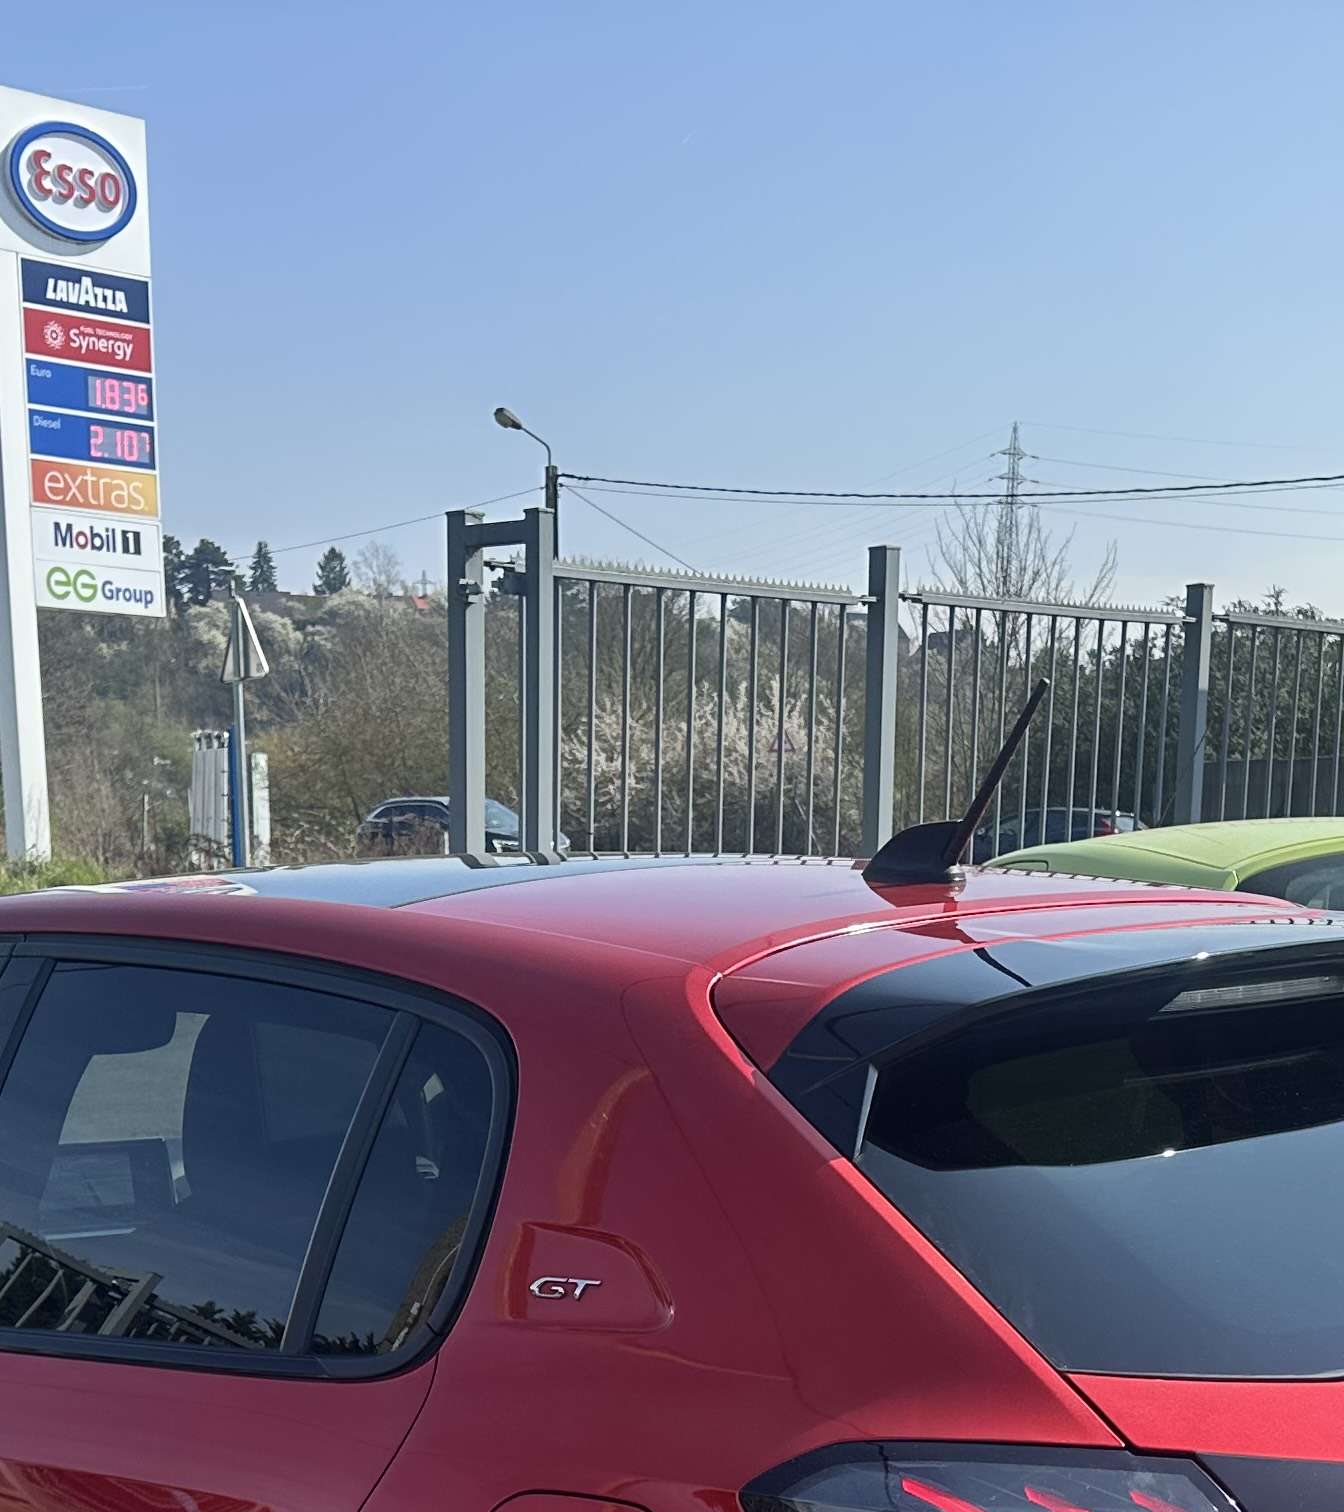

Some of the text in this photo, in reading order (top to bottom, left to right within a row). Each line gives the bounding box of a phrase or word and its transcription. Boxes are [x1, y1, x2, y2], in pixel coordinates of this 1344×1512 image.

[46, 276, 128, 313] LAVAZZA
[69, 328, 133, 361] Synergy
[30, 364, 52, 378] Euro
[33, 415, 61, 430] Diesel
[53, 521, 138, 555] Mobil 1
[101, 580, 154, 609] Group
[529, 1276, 603, 1301] GT
